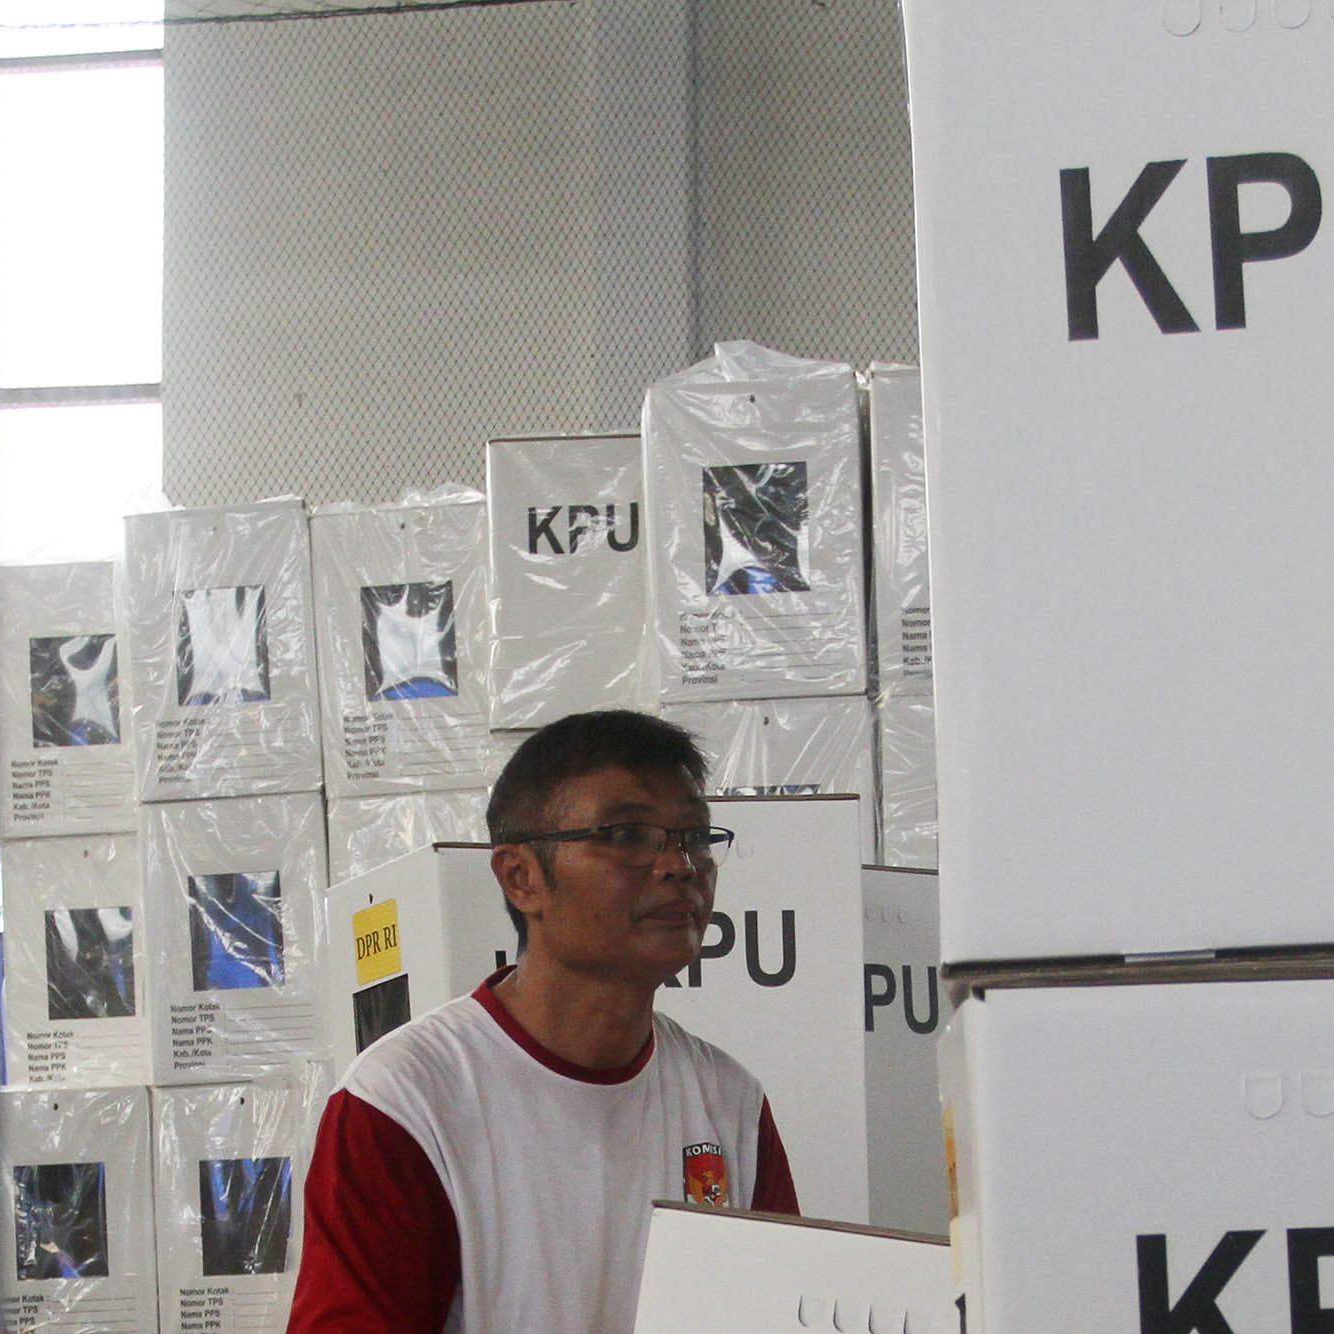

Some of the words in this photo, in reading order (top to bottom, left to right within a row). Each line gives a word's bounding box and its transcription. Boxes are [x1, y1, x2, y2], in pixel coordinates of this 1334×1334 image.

[528, 502, 639, 554] KPU
[356, 931, 381, 961] DPR
[383, 924, 397, 951] RI
[664, 910, 797, 987] PU
[864, 964, 939, 1035] PU
[199, 1013, 215, 1022] TPS
[180, 1288, 205, 1296] Nomor
[207, 1287, 229, 1295] Kotak
[207, 1298, 223, 1306] TPS
[181, 1322, 203, 1330] Nama
[204, 1320, 221, 1329] PPK
